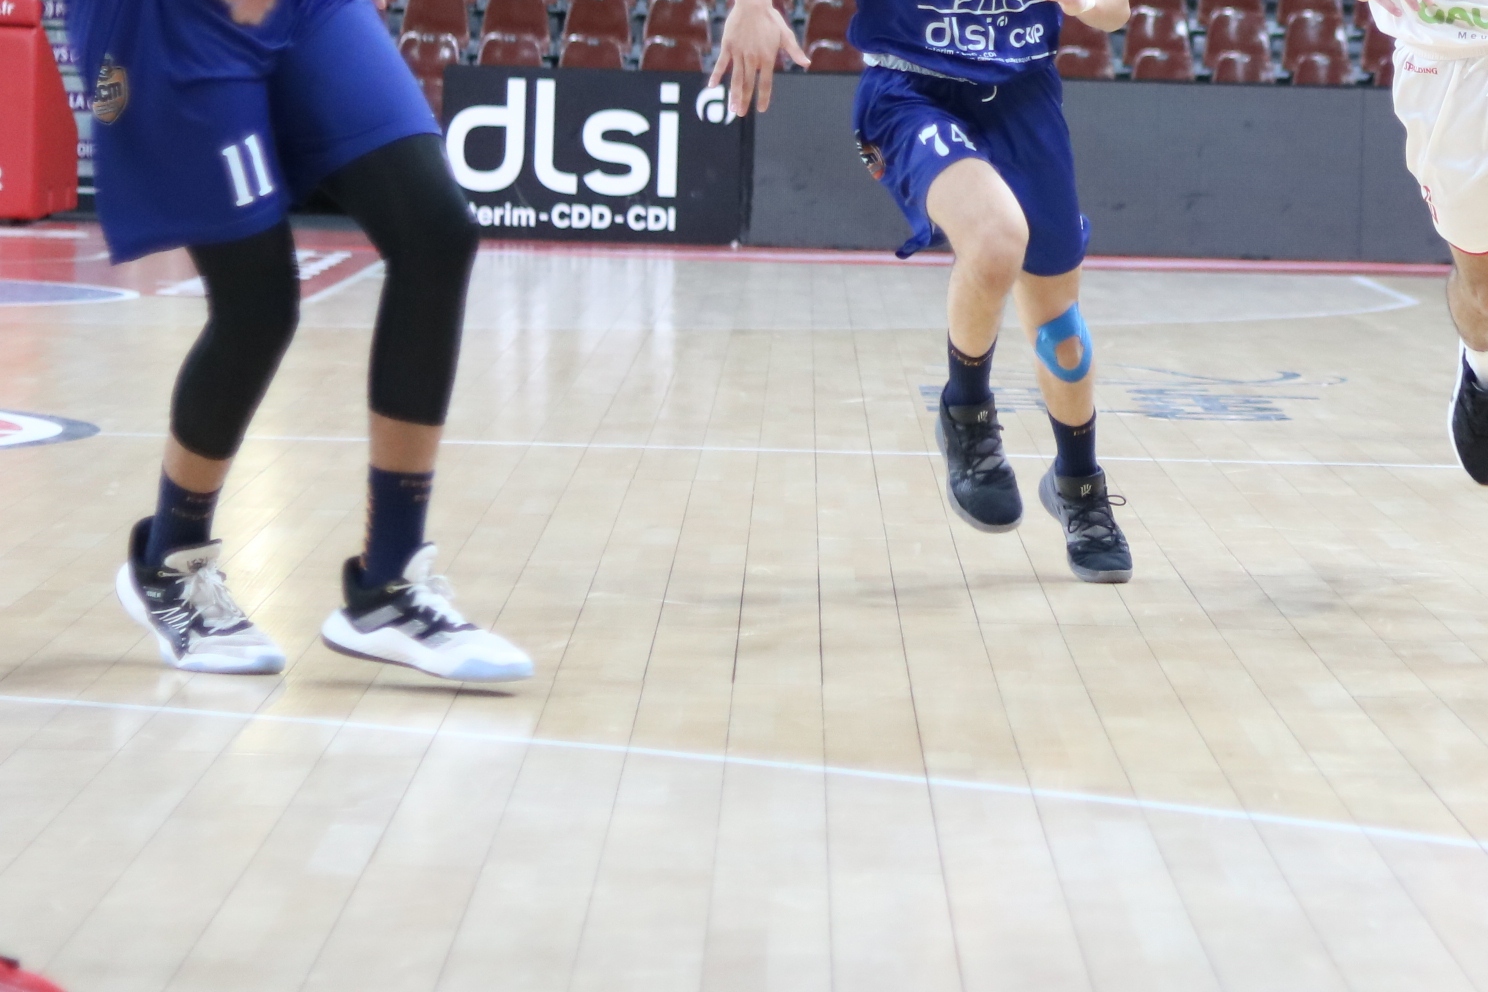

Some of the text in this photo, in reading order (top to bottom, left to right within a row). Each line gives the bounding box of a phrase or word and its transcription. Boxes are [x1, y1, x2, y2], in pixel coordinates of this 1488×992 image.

[925, 16, 996, 51] dlsi
[446, 77, 680, 198] dlsi
[918, 124, 977, 157] 74
[221, 134, 273, 207] 11
